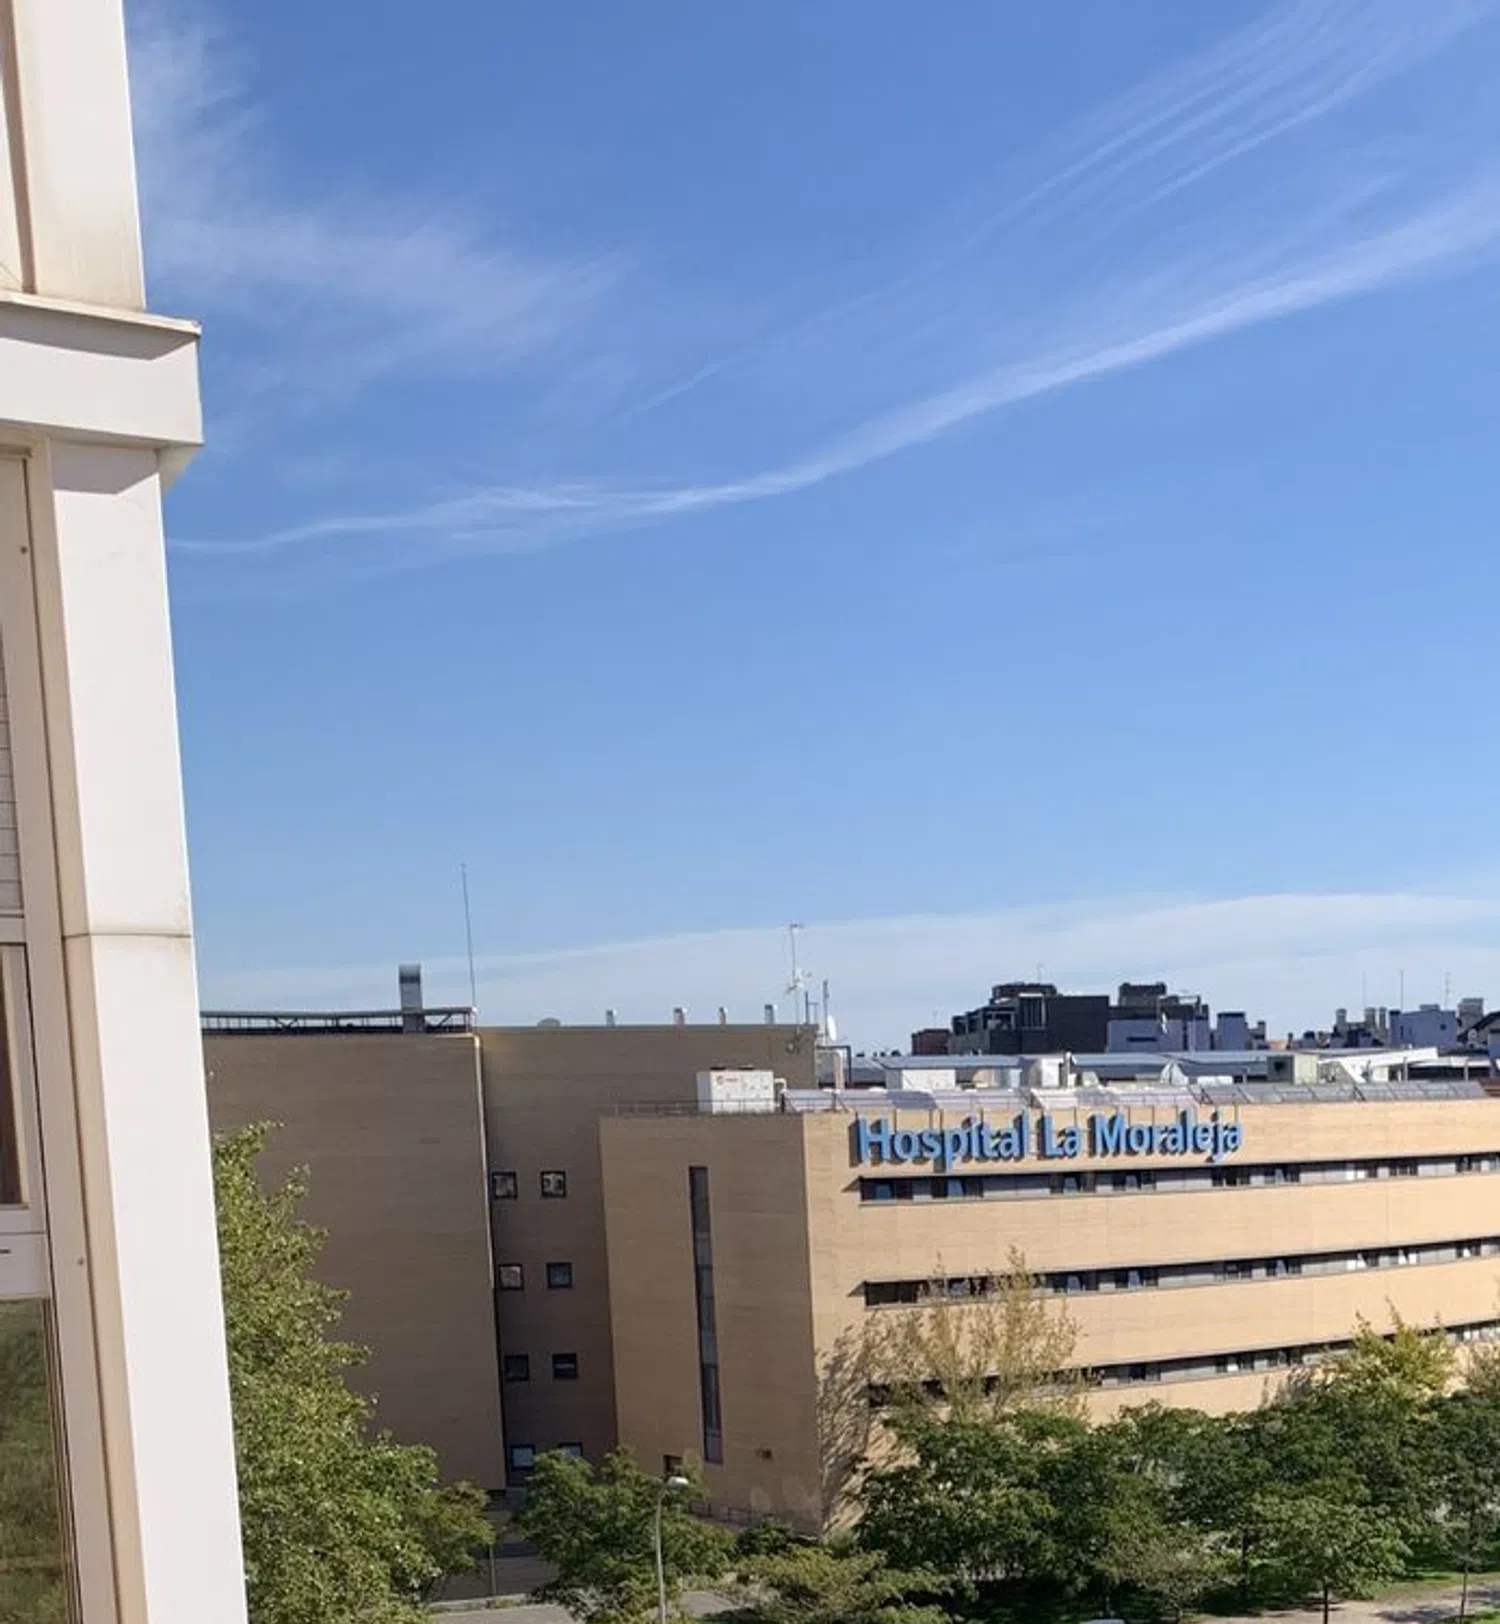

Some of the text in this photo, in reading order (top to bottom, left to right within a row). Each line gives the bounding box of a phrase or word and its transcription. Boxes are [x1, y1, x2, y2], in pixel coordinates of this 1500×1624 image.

[856, 1105, 1241, 1172] Hospital La Moraleja
